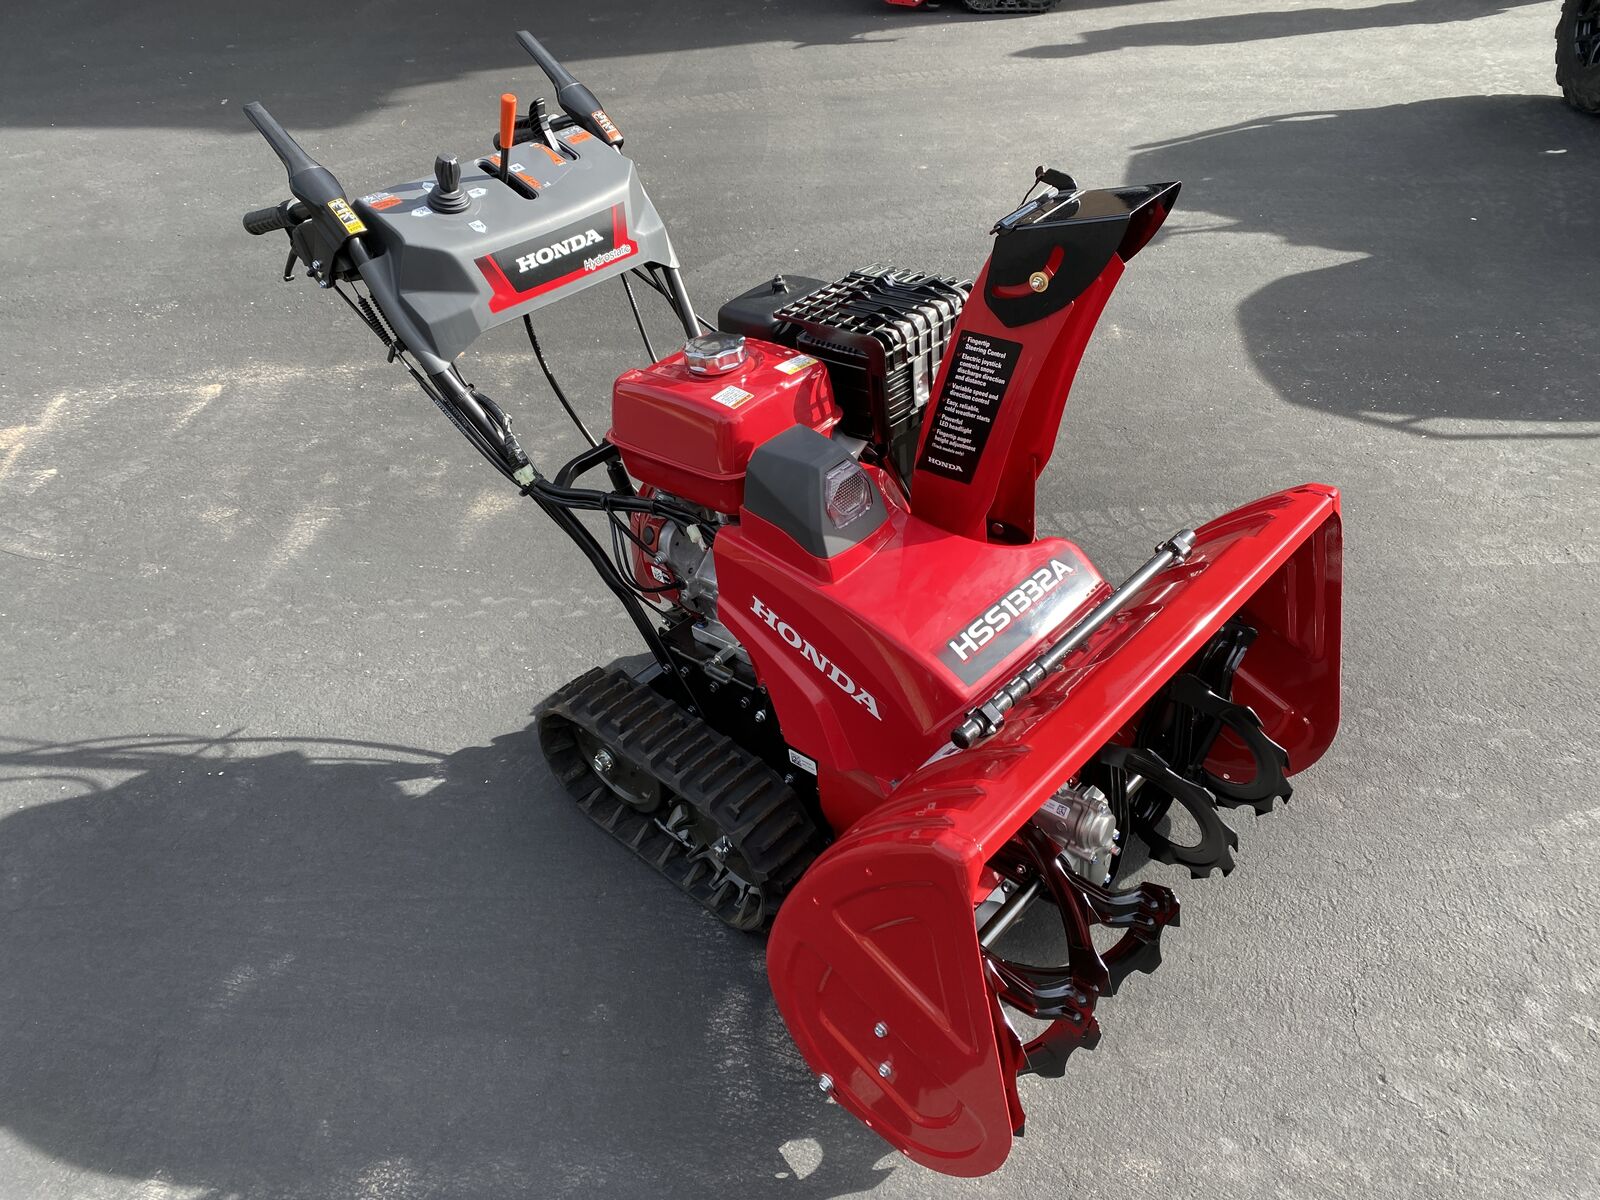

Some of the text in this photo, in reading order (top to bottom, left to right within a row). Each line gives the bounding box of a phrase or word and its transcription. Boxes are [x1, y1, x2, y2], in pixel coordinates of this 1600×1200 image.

[515, 228, 604, 274] HONDA
[583, 243, 632, 272] Hydrostatic
[967, 336, 990, 348] Fingertip
[965, 343, 1007, 359] Steering Control
[959, 361, 995, 374] controls snow
[961, 352, 1002, 369] Electric joystick
[957, 367, 1006, 385] discharge direction
[964, 376, 987, 387] distance
[949, 389, 990, 405] direction control
[952, 382, 999, 401] Variable speed and
[944, 405, 991, 423] cold weather starts
[946, 398, 980, 414] Easy, reliable,
[941, 413, 964, 425] Powerful
[939, 420, 972, 435] LED headlight
[934, 434, 976, 452] height adjustment
[936, 428, 972, 444] Fingertip auger
[928, 456, 963, 472] HONDA
[948, 559, 1074, 661] HSS1332A
[749, 595, 882, 721] HONDA
